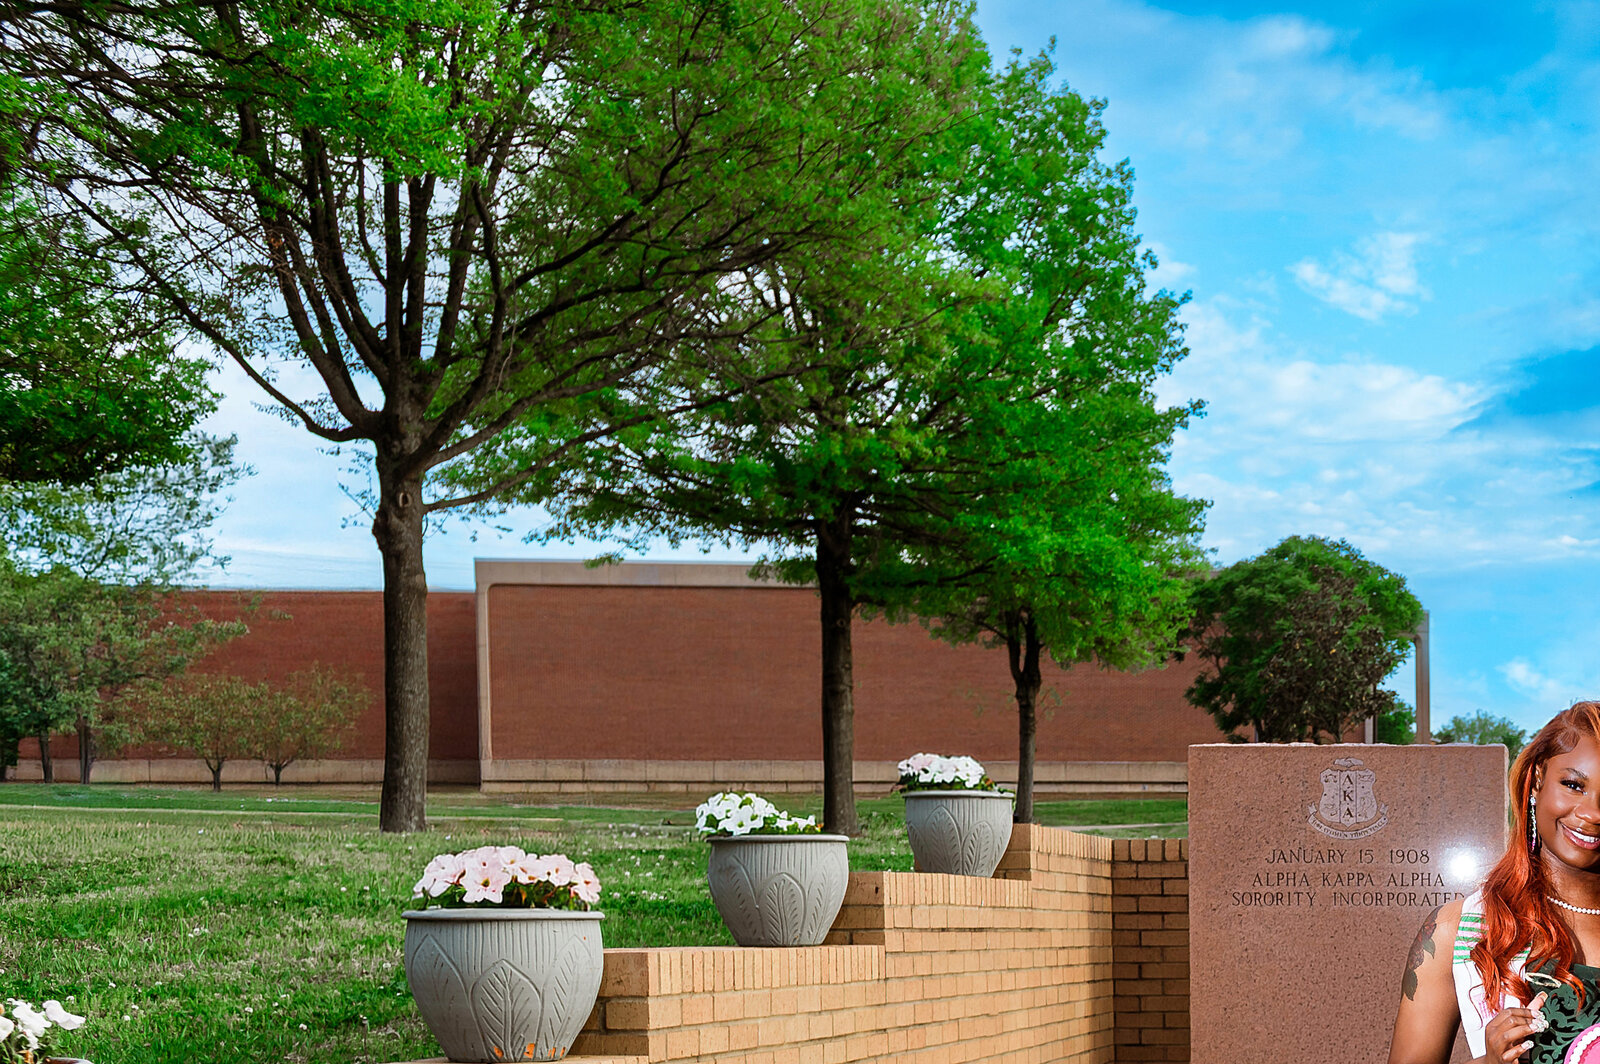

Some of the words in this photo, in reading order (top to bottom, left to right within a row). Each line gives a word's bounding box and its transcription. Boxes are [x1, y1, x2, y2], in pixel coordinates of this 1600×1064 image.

[1265, 849, 1346, 864] JANUARY
[1389, 849, 1430, 864] 1908
[1252, 872, 1311, 887] ALPHA
[1321, 872, 1375, 887] KAPPA
[1386, 872, 1445, 887] ALPHA
